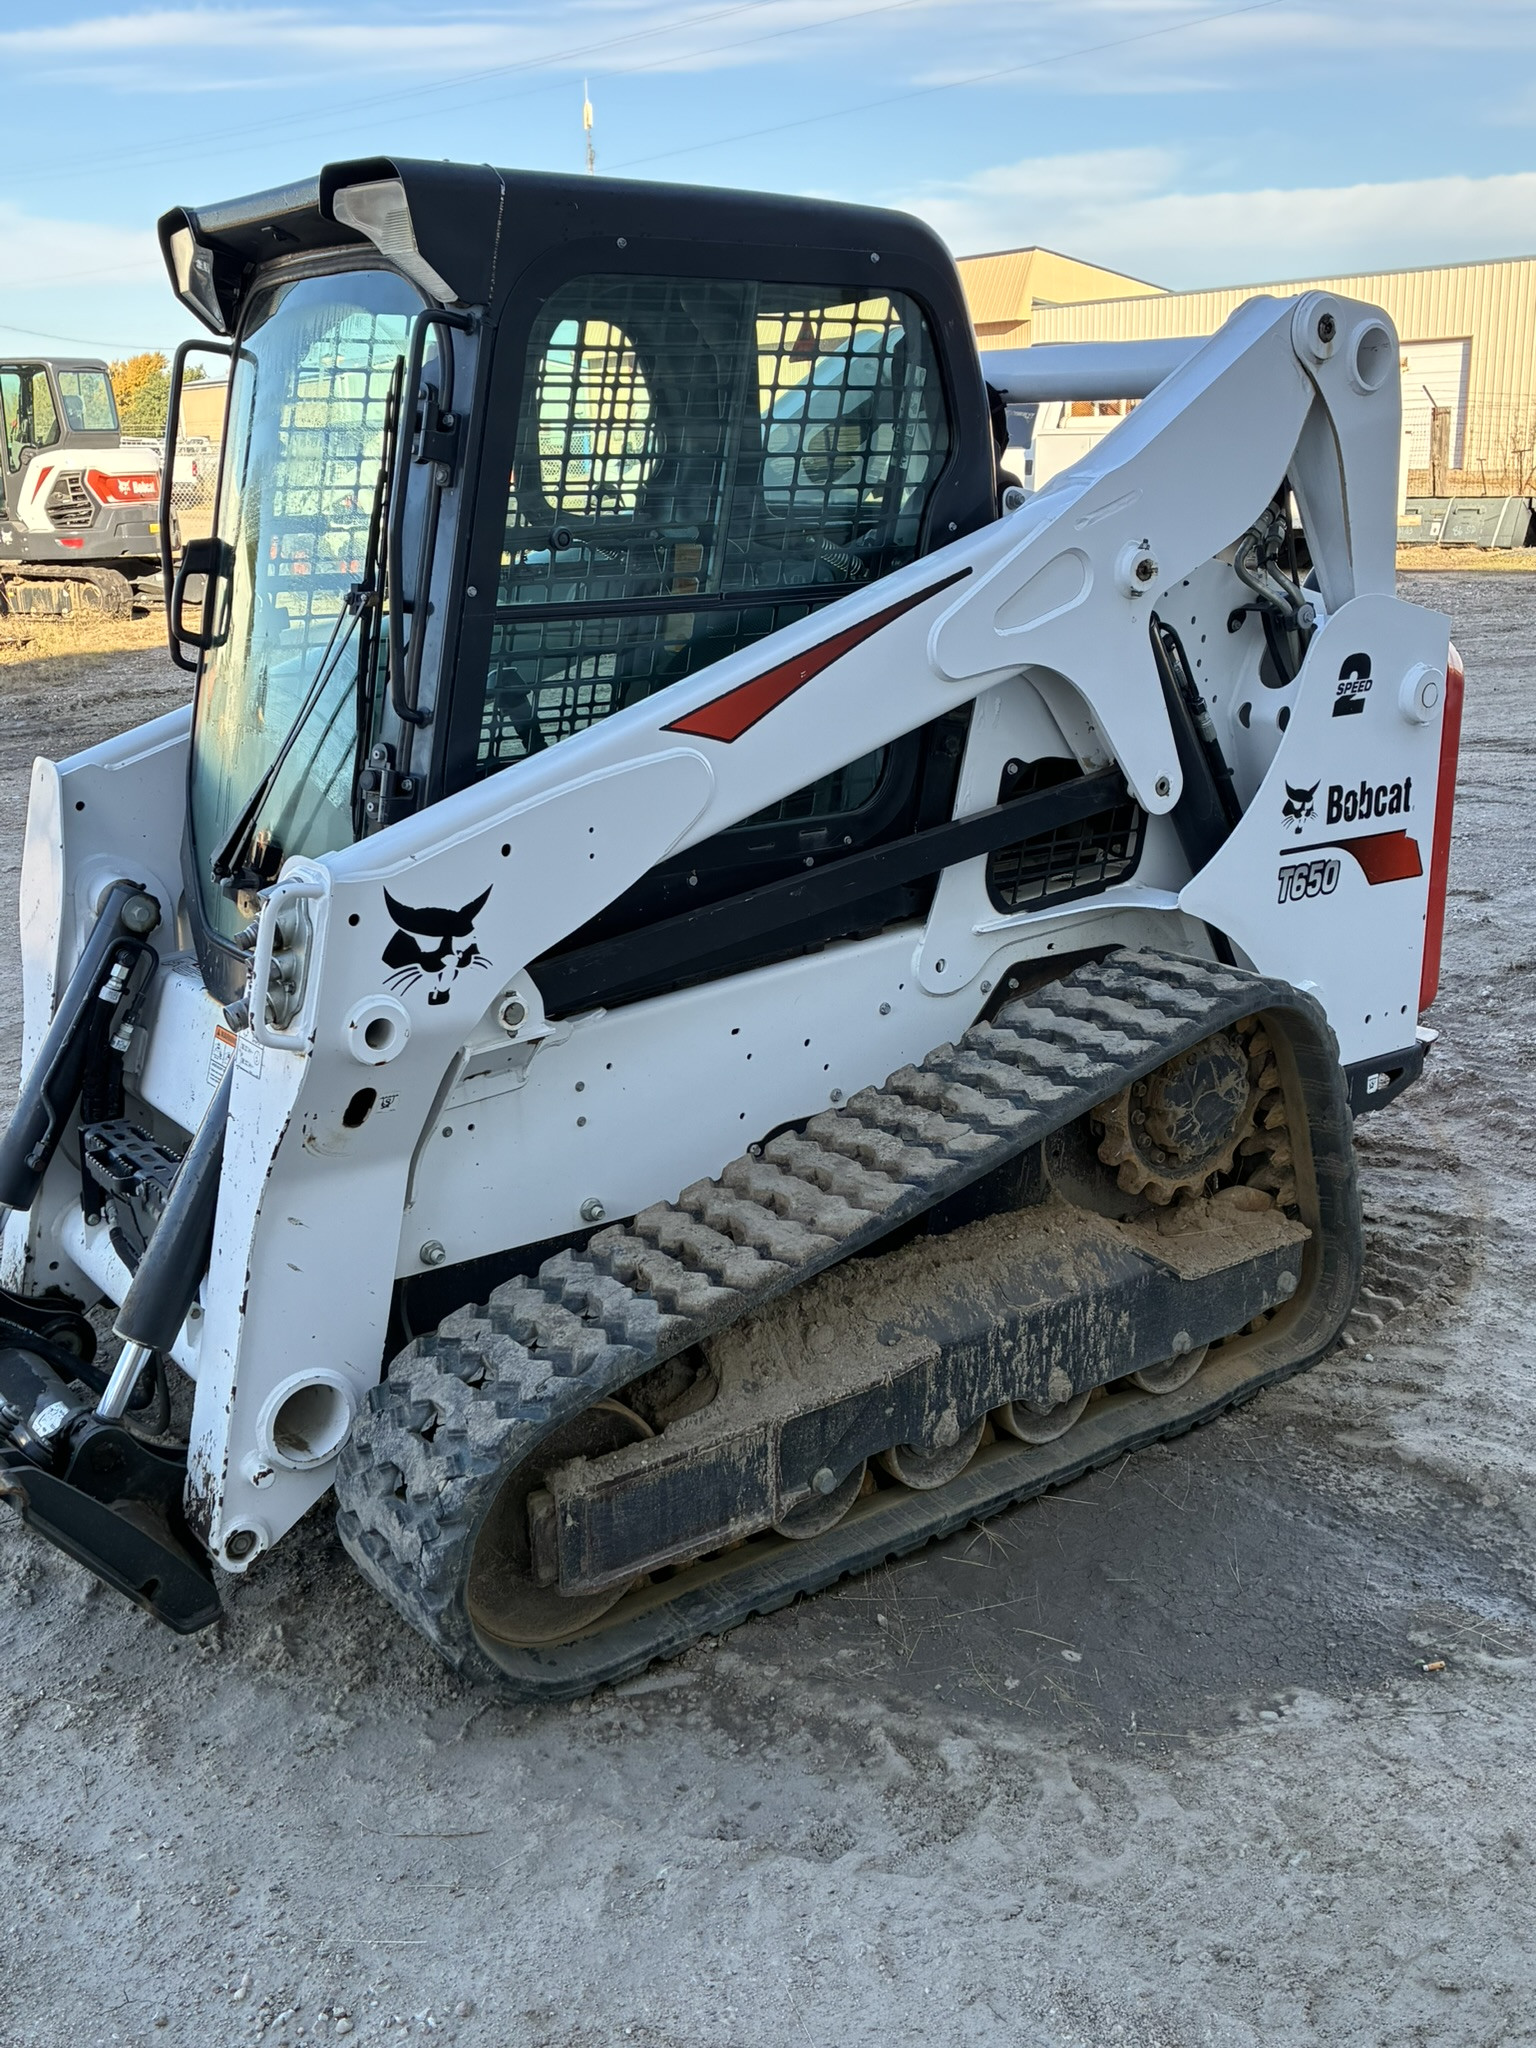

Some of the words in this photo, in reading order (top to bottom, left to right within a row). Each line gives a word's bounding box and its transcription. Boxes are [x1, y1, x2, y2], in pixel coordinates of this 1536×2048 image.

[1331, 653, 1372, 718] 2
[1336, 679, 1373, 696] SPEED
[1326, 777, 1412, 825] Bobcat
[1277, 859, 1341, 904] T650
